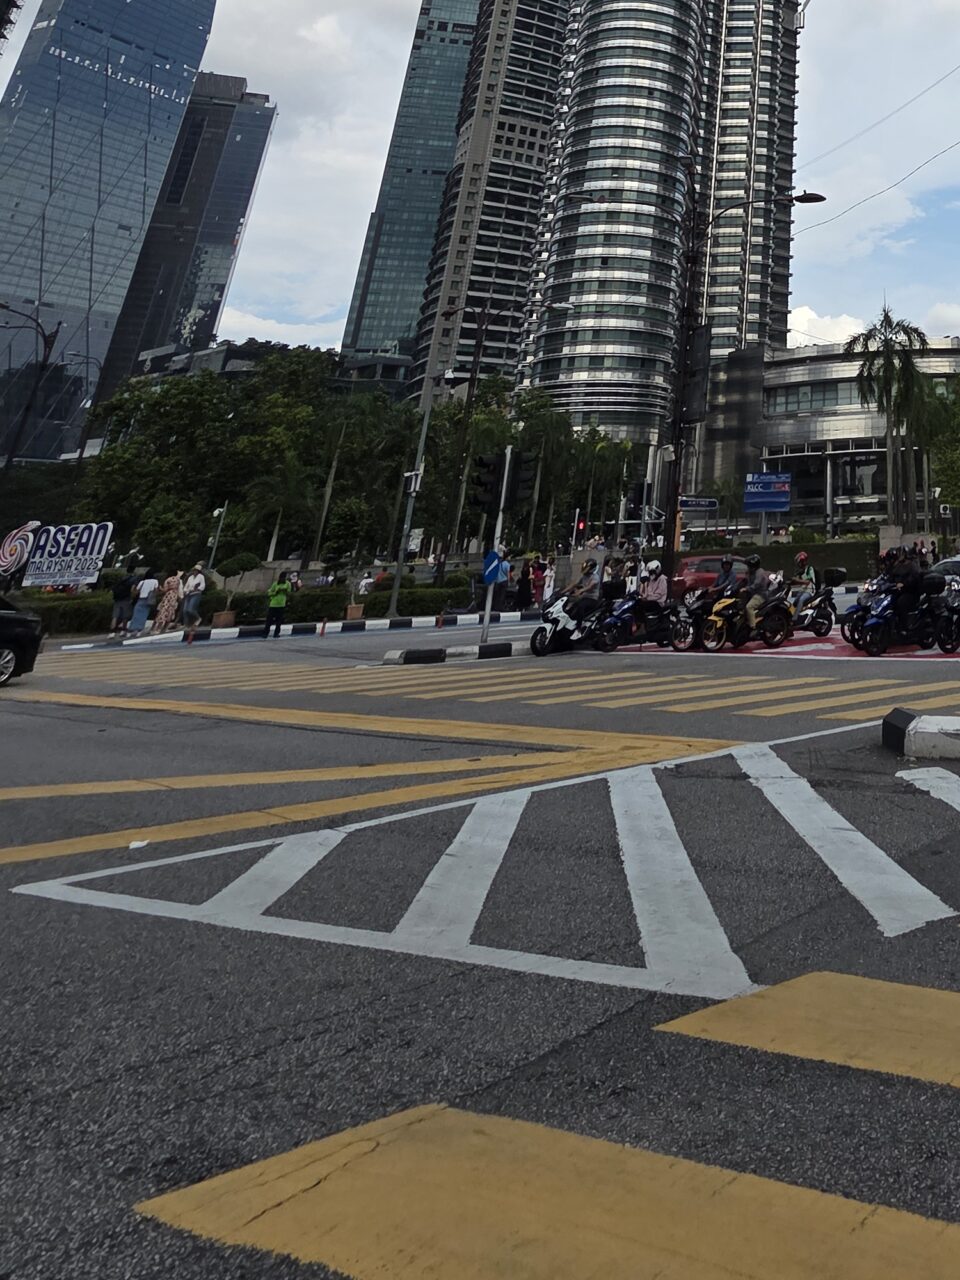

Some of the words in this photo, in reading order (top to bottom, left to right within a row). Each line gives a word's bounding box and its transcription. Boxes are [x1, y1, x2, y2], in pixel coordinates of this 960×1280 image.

[747, 483, 763, 491] KLCC
[31, 523, 109, 559] ASEAN
[29, 559, 74, 572] MALAYSIA
[75, 557, 99, 570] 2025
